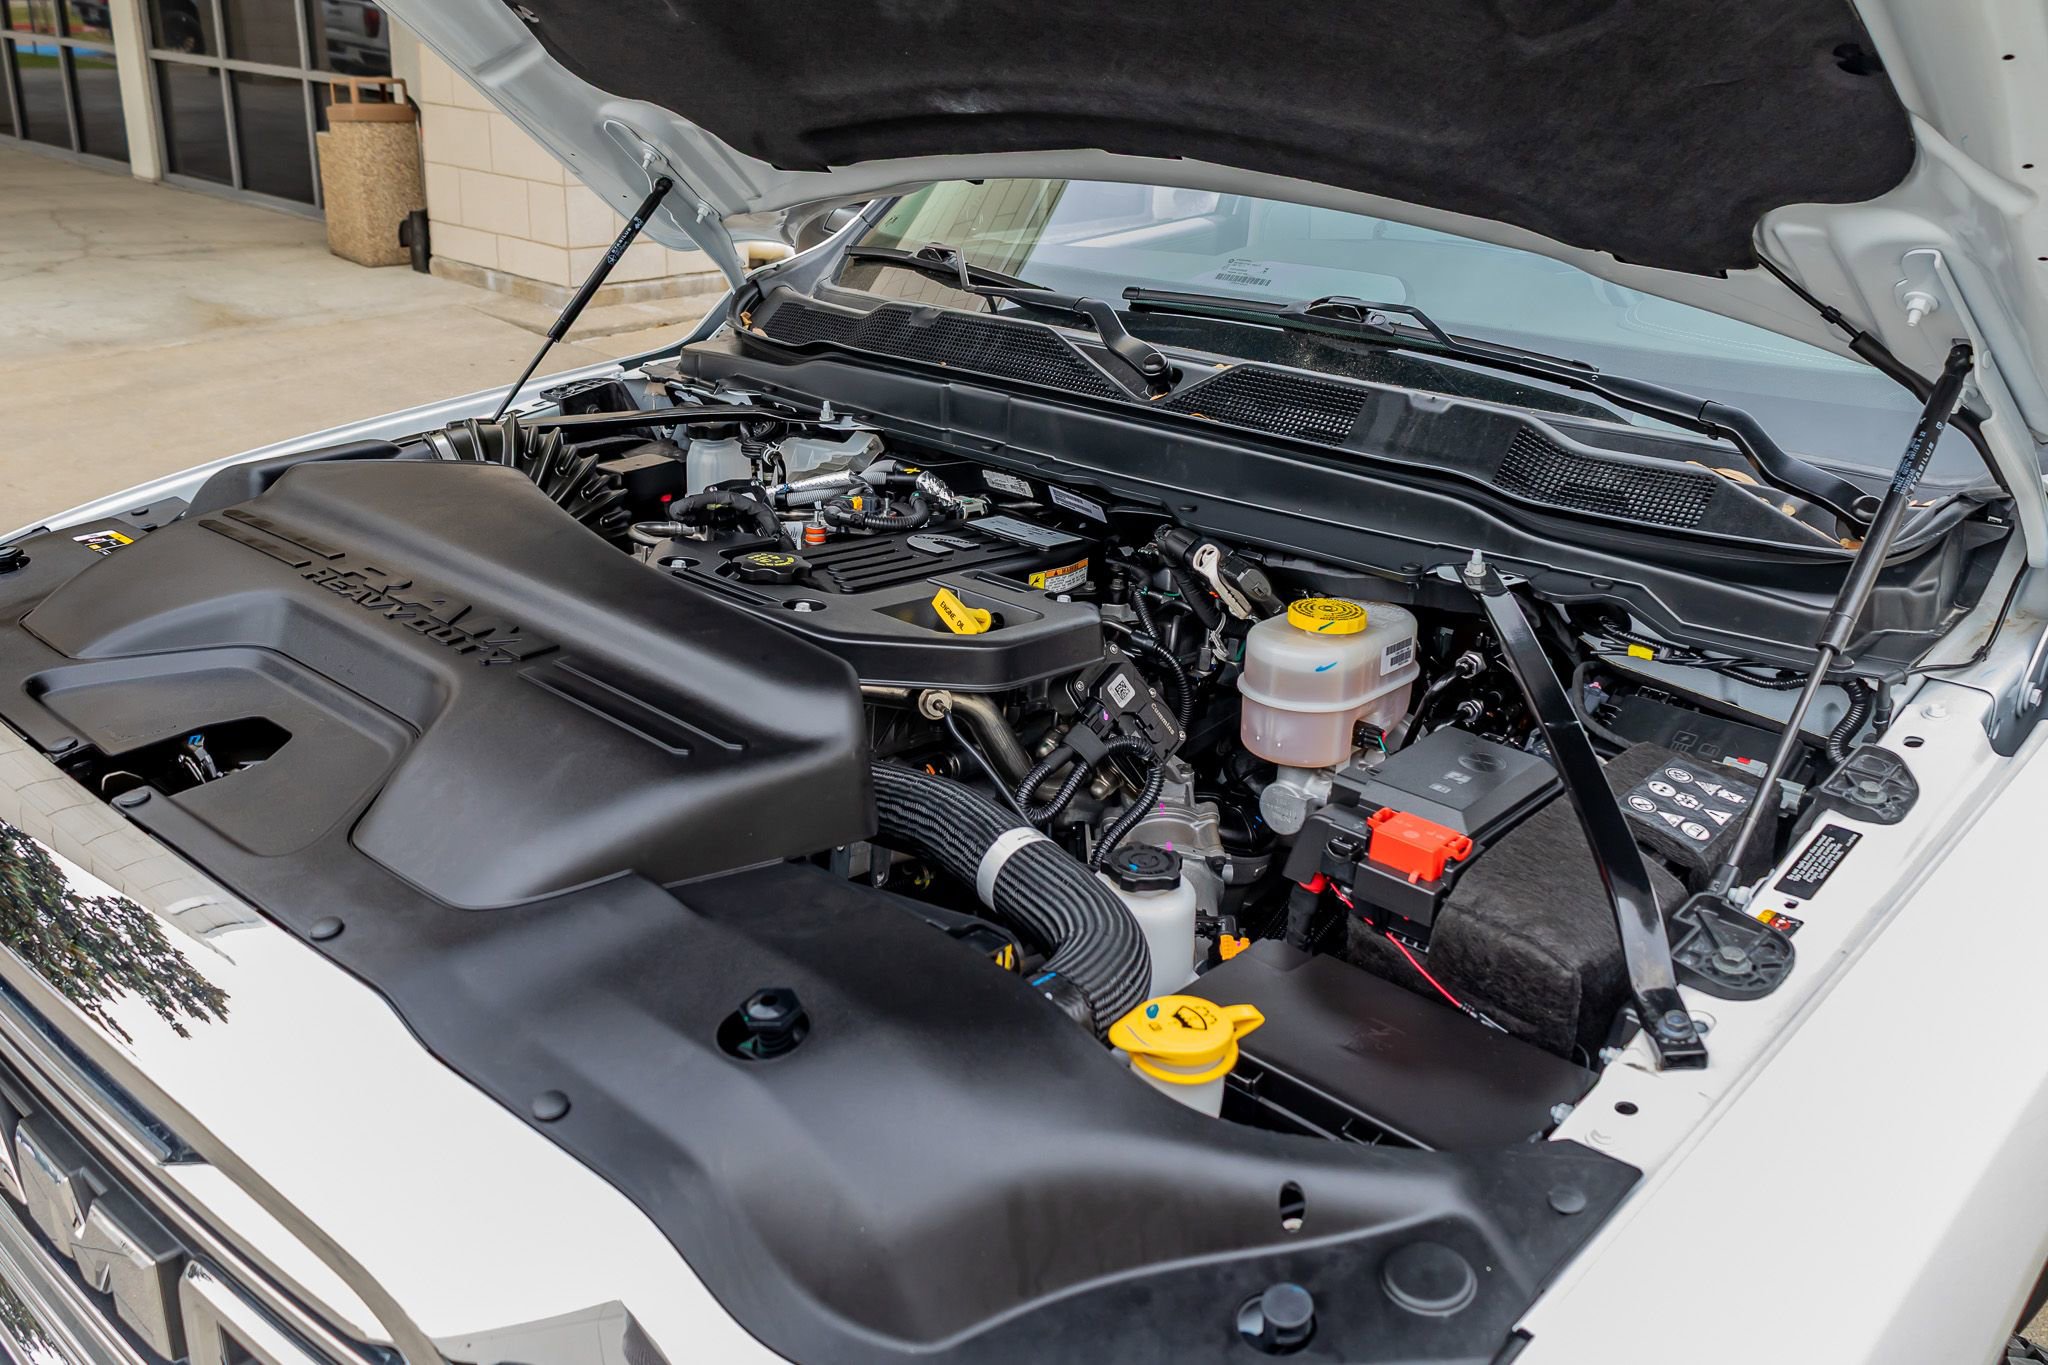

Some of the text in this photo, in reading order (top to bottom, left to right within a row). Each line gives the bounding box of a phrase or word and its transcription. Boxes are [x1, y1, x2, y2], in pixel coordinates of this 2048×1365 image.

[1908, 442, 1935, 490] STABILUS
[301, 568, 514, 666] HEAVY DUTY
[326, 560, 561, 661] RAM
[940, 600, 966, 632] ENGINE OIL
[1151, 703, 1174, 735] Cummins
